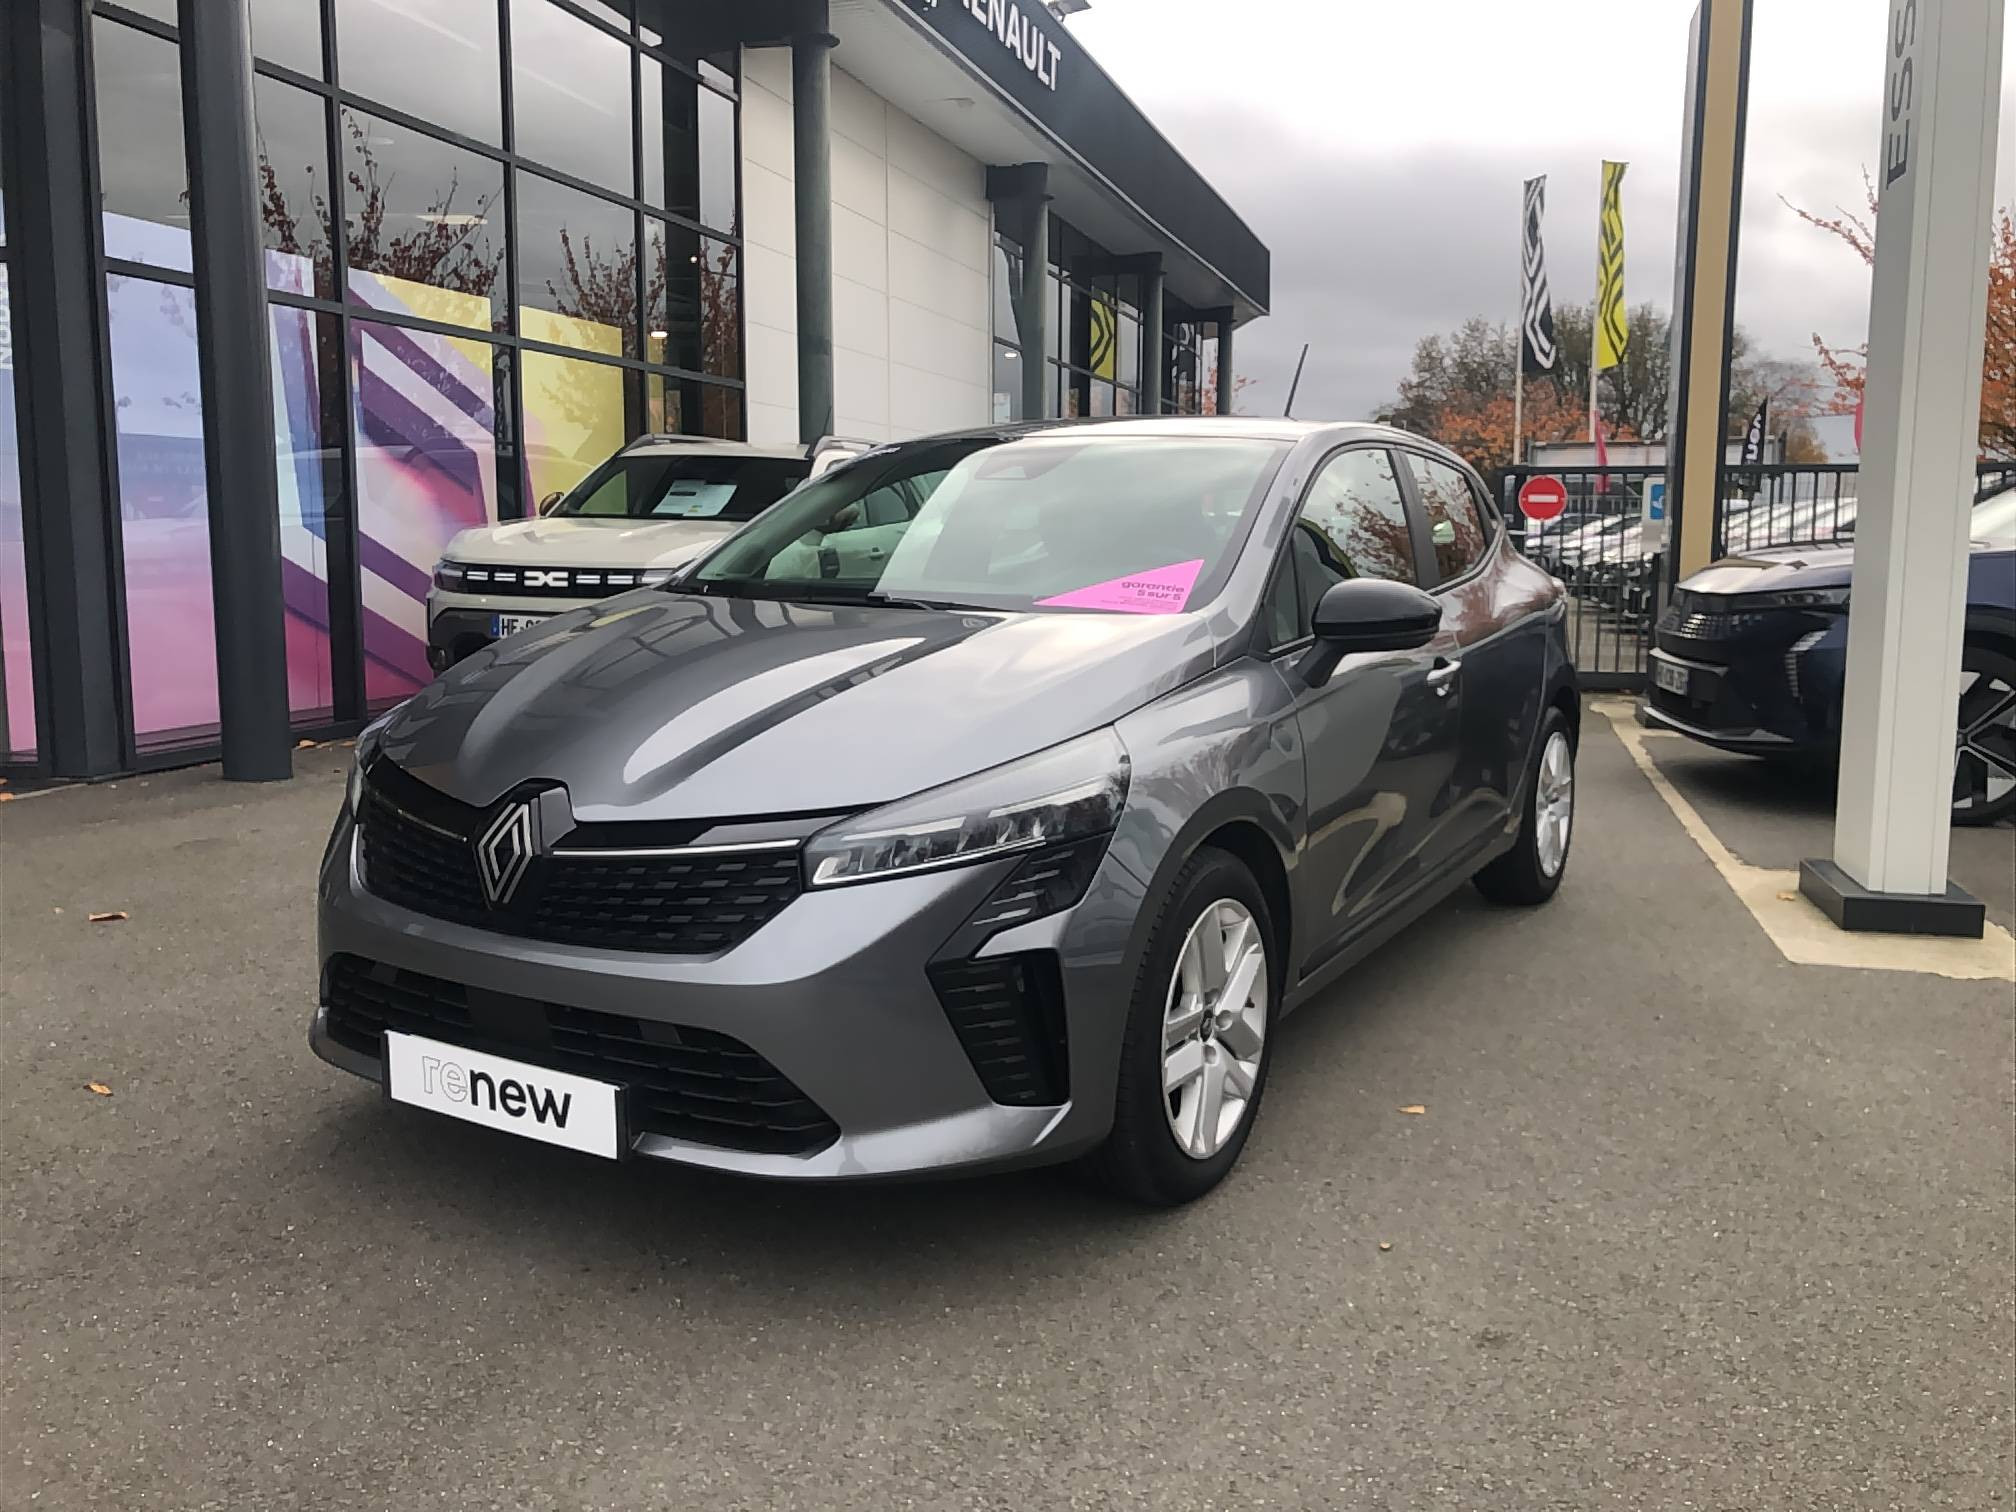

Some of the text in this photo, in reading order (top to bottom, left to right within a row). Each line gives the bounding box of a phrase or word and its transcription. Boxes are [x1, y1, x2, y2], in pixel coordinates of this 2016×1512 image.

[963, 0, 1061, 91] NAULT
[1121, 581, 1185, 593] garantie
[1148, 591, 1170, 599] sur
[422, 1056, 572, 1128] renew
